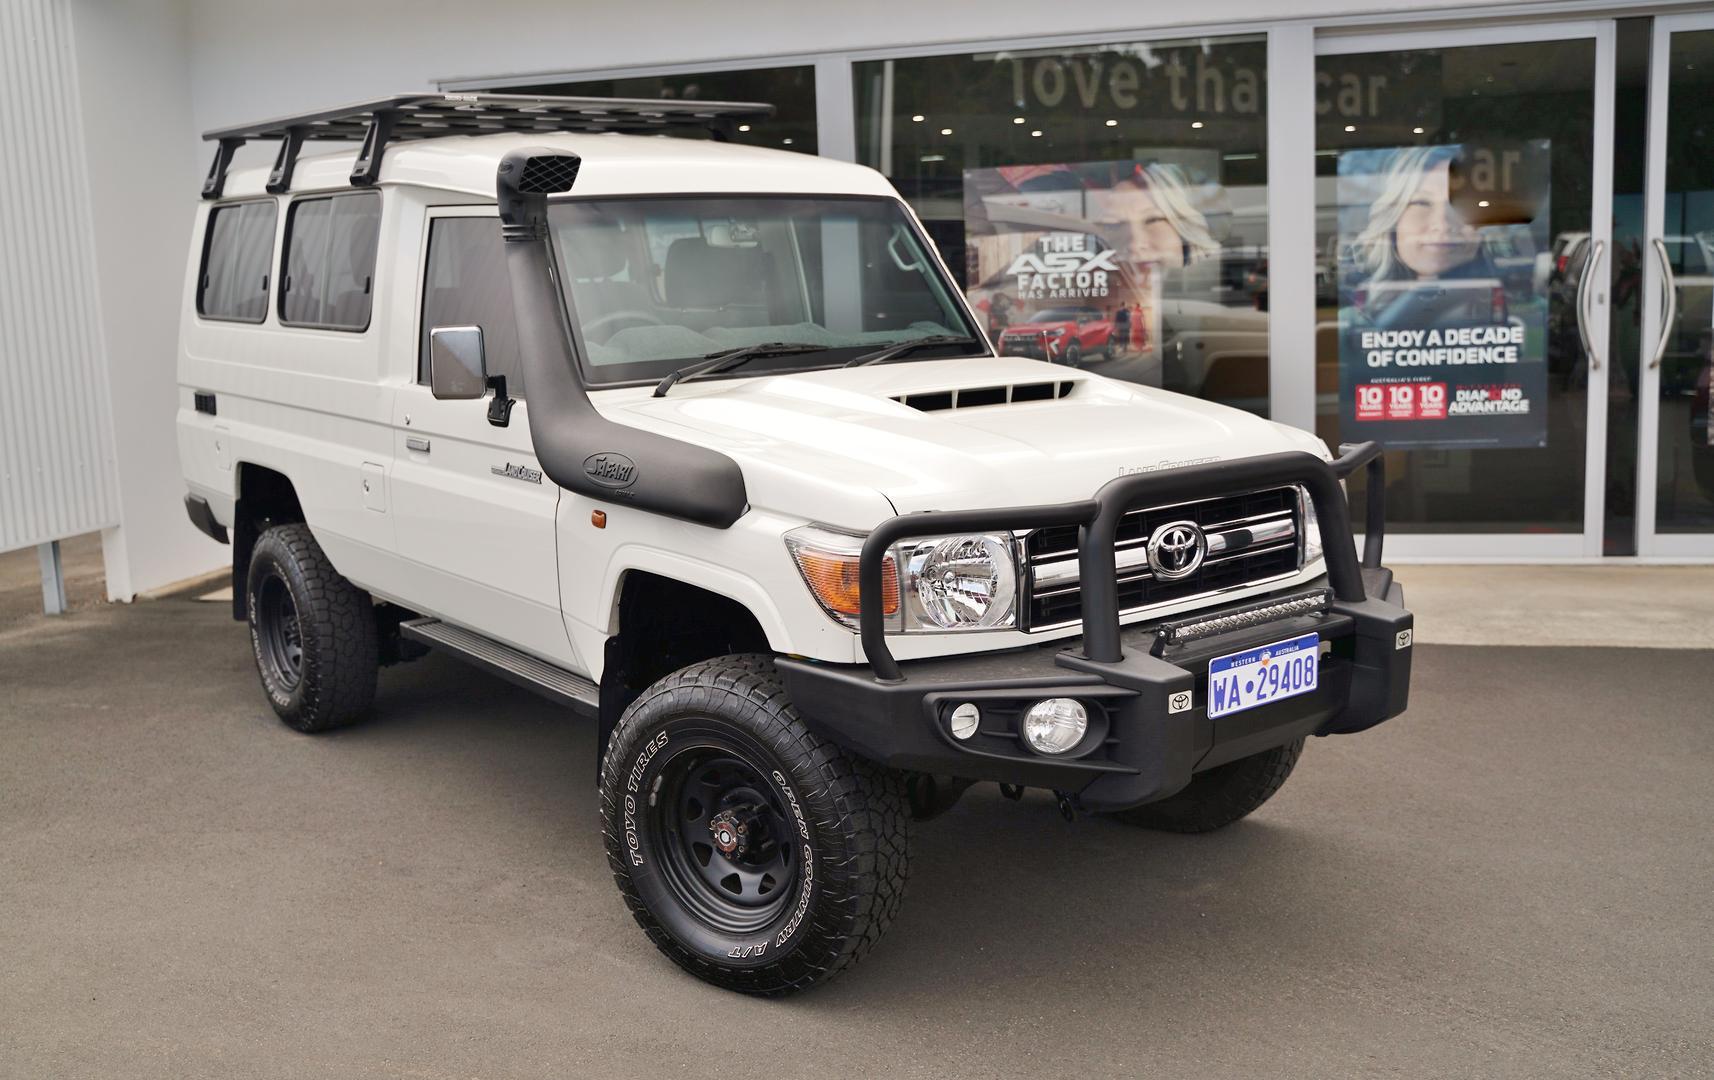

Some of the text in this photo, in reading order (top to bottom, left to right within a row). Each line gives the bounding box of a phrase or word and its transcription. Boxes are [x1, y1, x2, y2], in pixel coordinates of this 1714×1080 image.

[1013, 56, 1140, 109] love
[1165, 50, 1266, 113] tha
[1040, 235, 1085, 253] THE
[1006, 249, 1120, 275] ASX
[1017, 271, 1108, 290] FACTOR
[1018, 288, 1109, 299] HAS ARRIVED
[1361, 326, 1524, 348] ENJOY A DECADE
[1367, 346, 1518, 367] OF CONFIDENCE
[1358, 385, 1444, 404] 10 10 10
[1448, 399, 1530, 414] ADVANTAGE
[587, 456, 634, 482] SAFARI
[1231, 645, 1300, 668] WESTERN AUSTRALIA
[625, 730, 669, 866] TOYO TIRES
[728, 770, 813, 958] OPEN COUNTRY A/T
